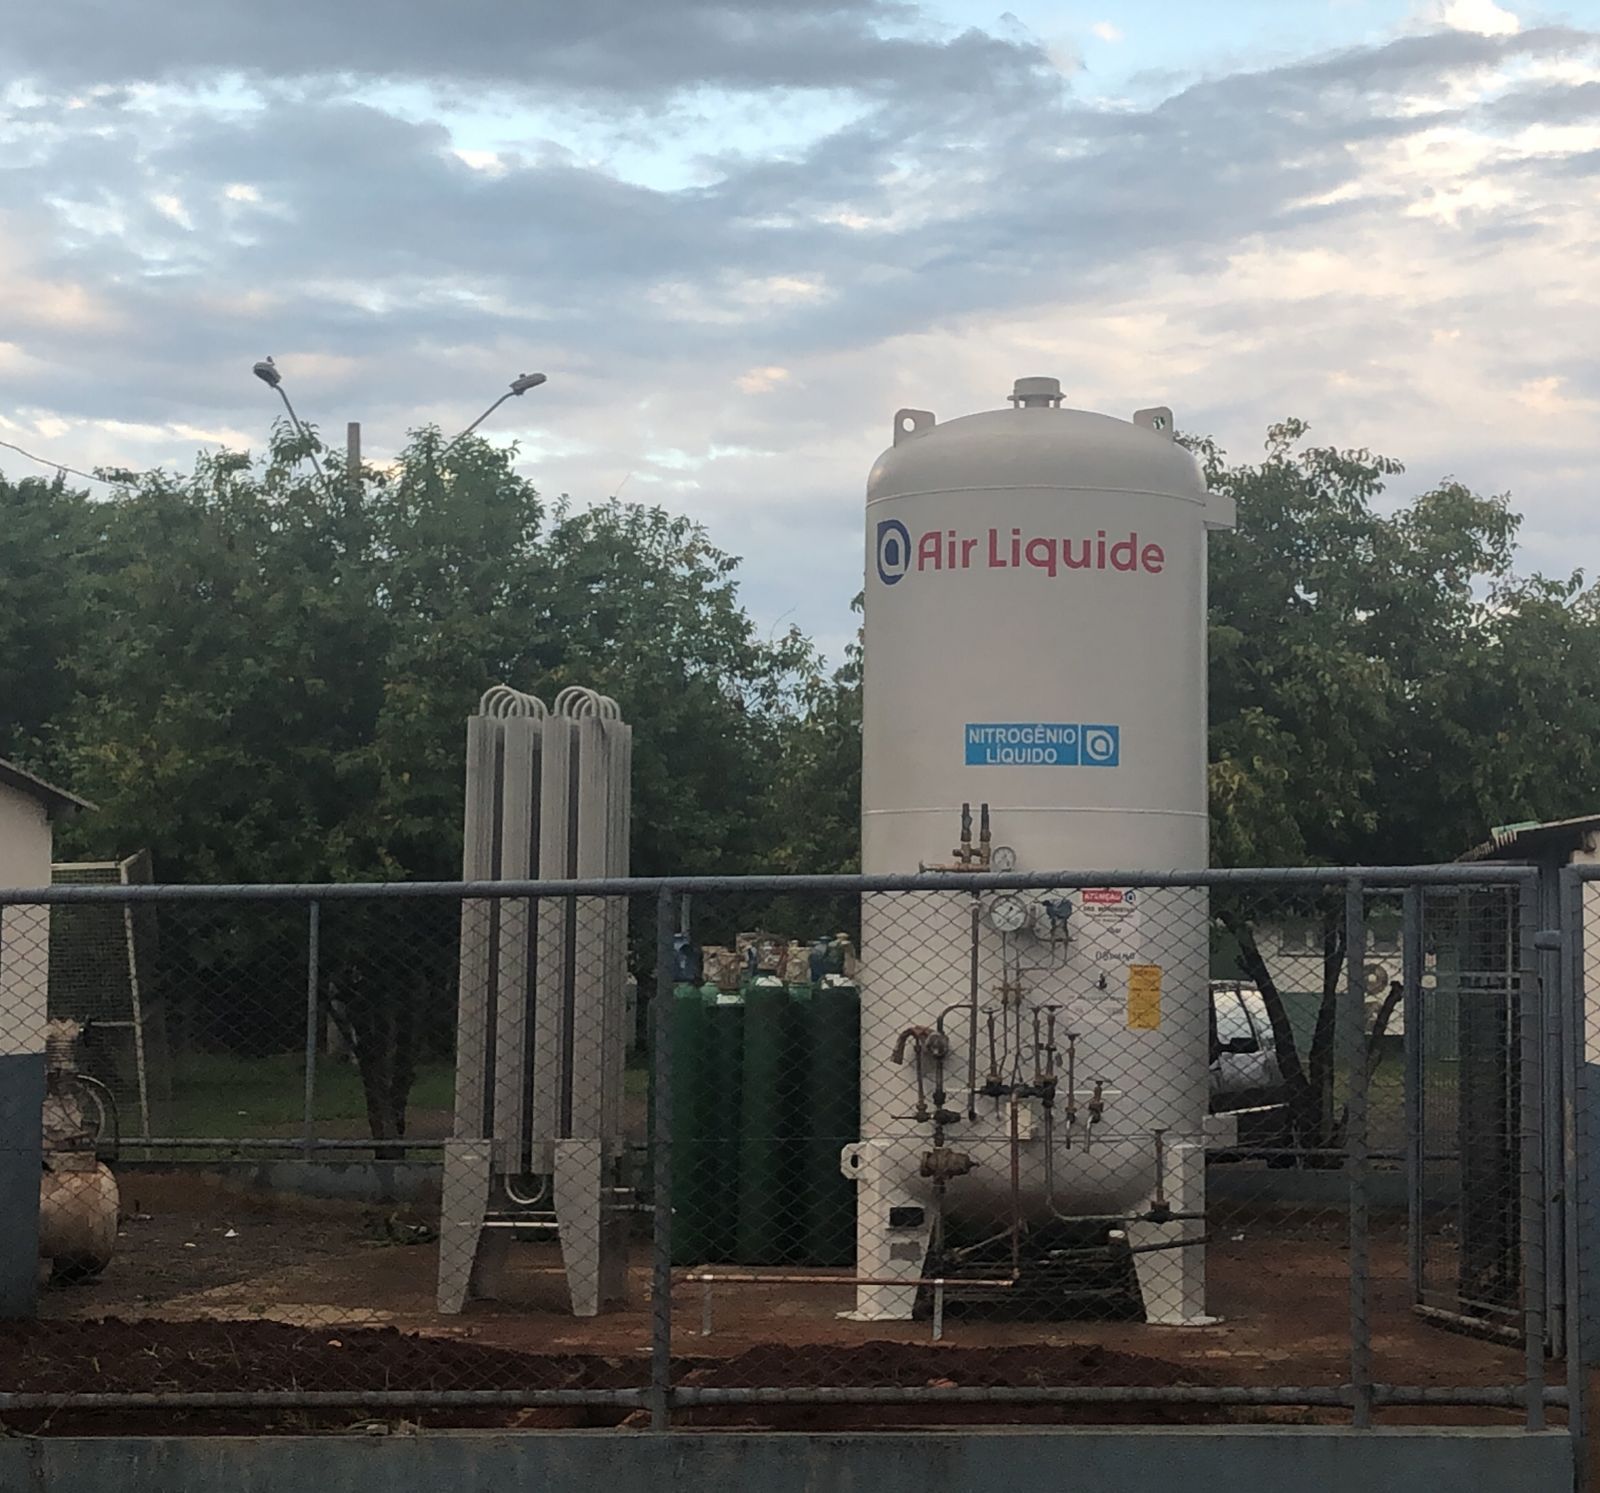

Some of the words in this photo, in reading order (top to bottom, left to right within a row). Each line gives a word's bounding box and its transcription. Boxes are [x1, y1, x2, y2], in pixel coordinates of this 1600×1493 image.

[918, 530, 978, 571] Air
[988, 528, 1165, 577] Liquide
[969, 724, 1076, 744] NITROGÊNIO
[986, 745, 1057, 764] LÍQUIDO
